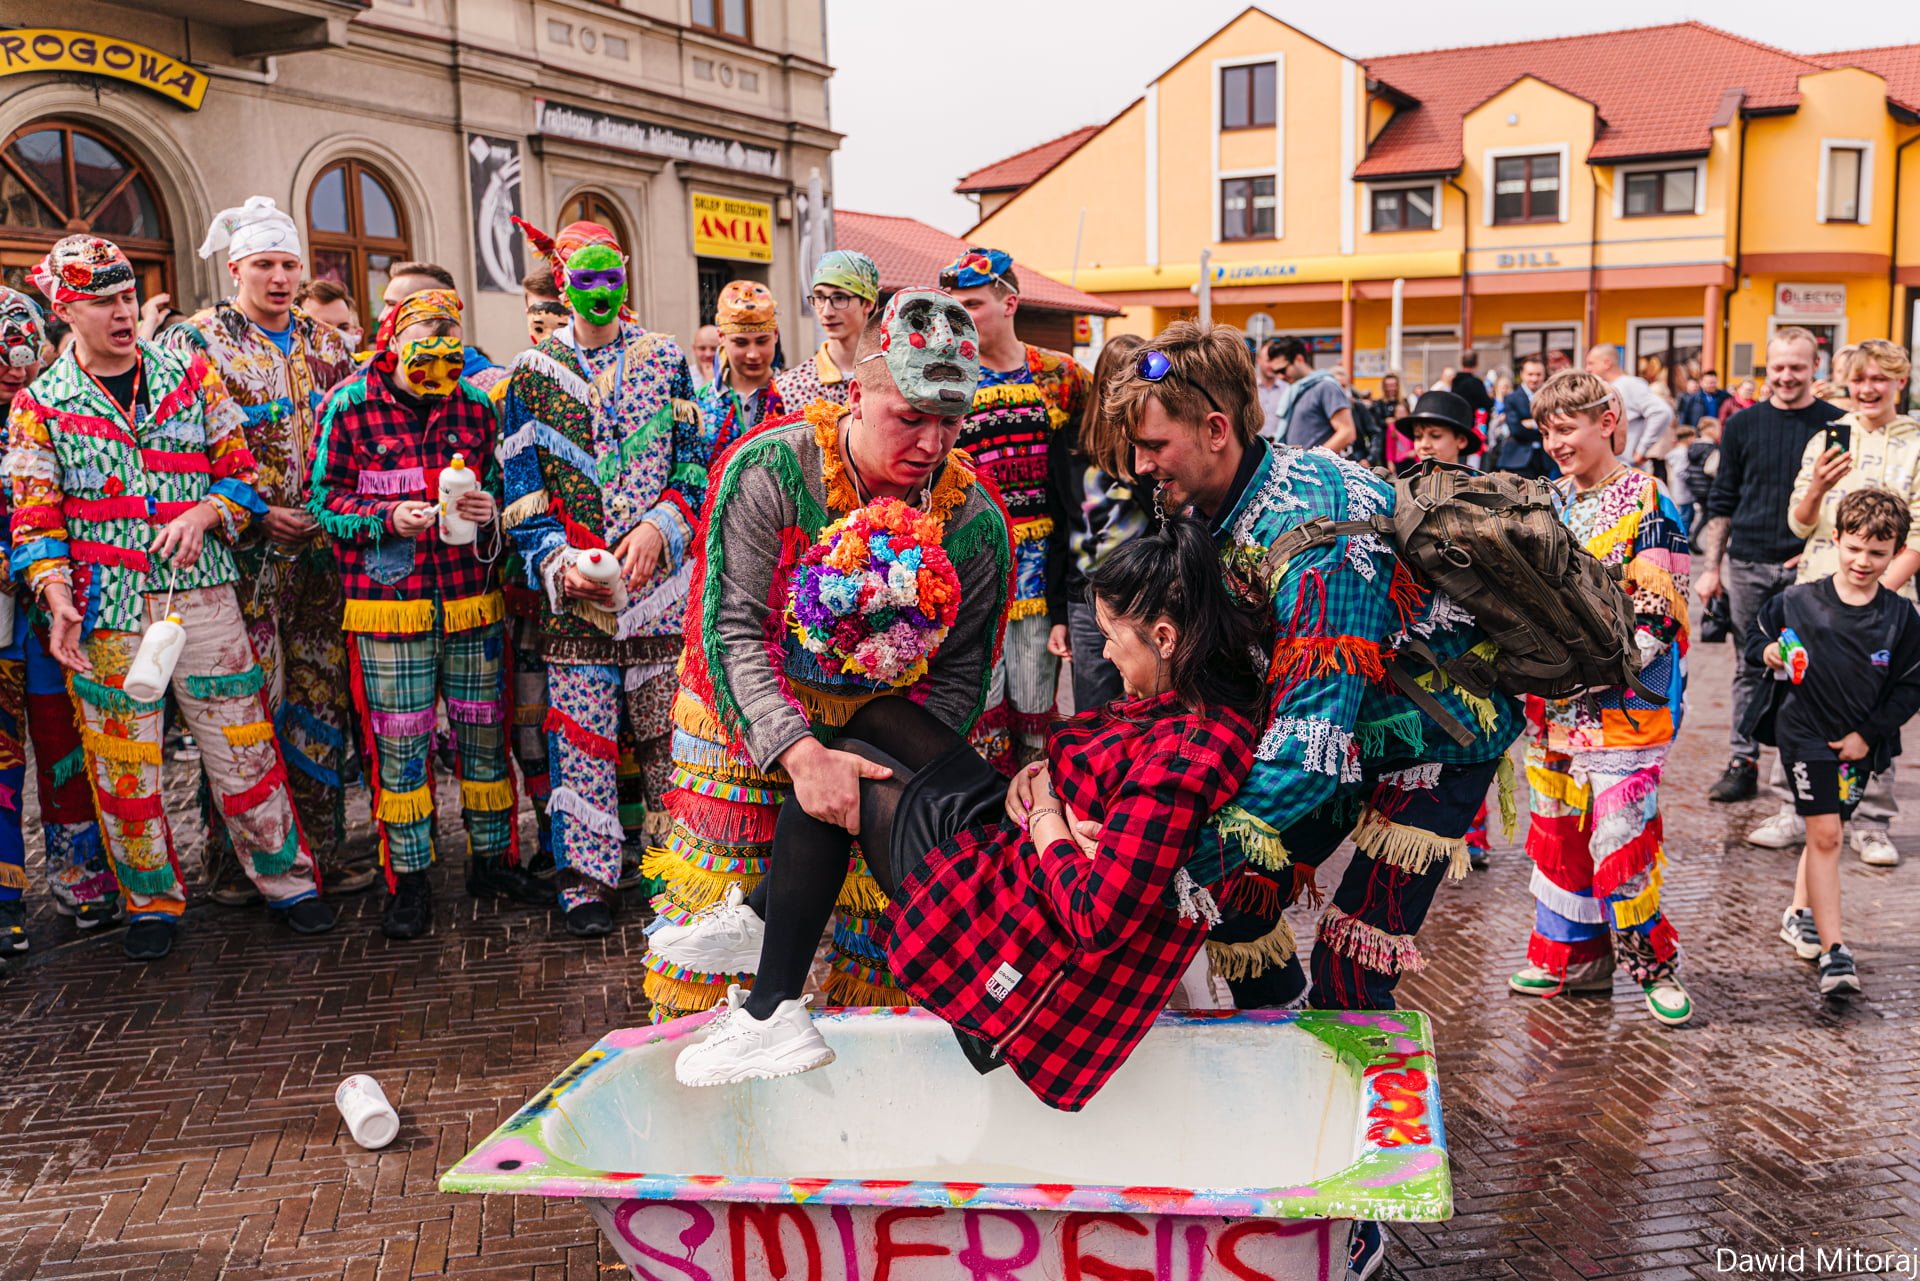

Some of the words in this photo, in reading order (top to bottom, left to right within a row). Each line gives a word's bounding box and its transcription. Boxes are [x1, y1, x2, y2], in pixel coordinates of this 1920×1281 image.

[0, 35, 197, 97] ROGOWA
[697, 215, 768, 245] ANCIA
[1496, 252, 1557, 267] BILL
